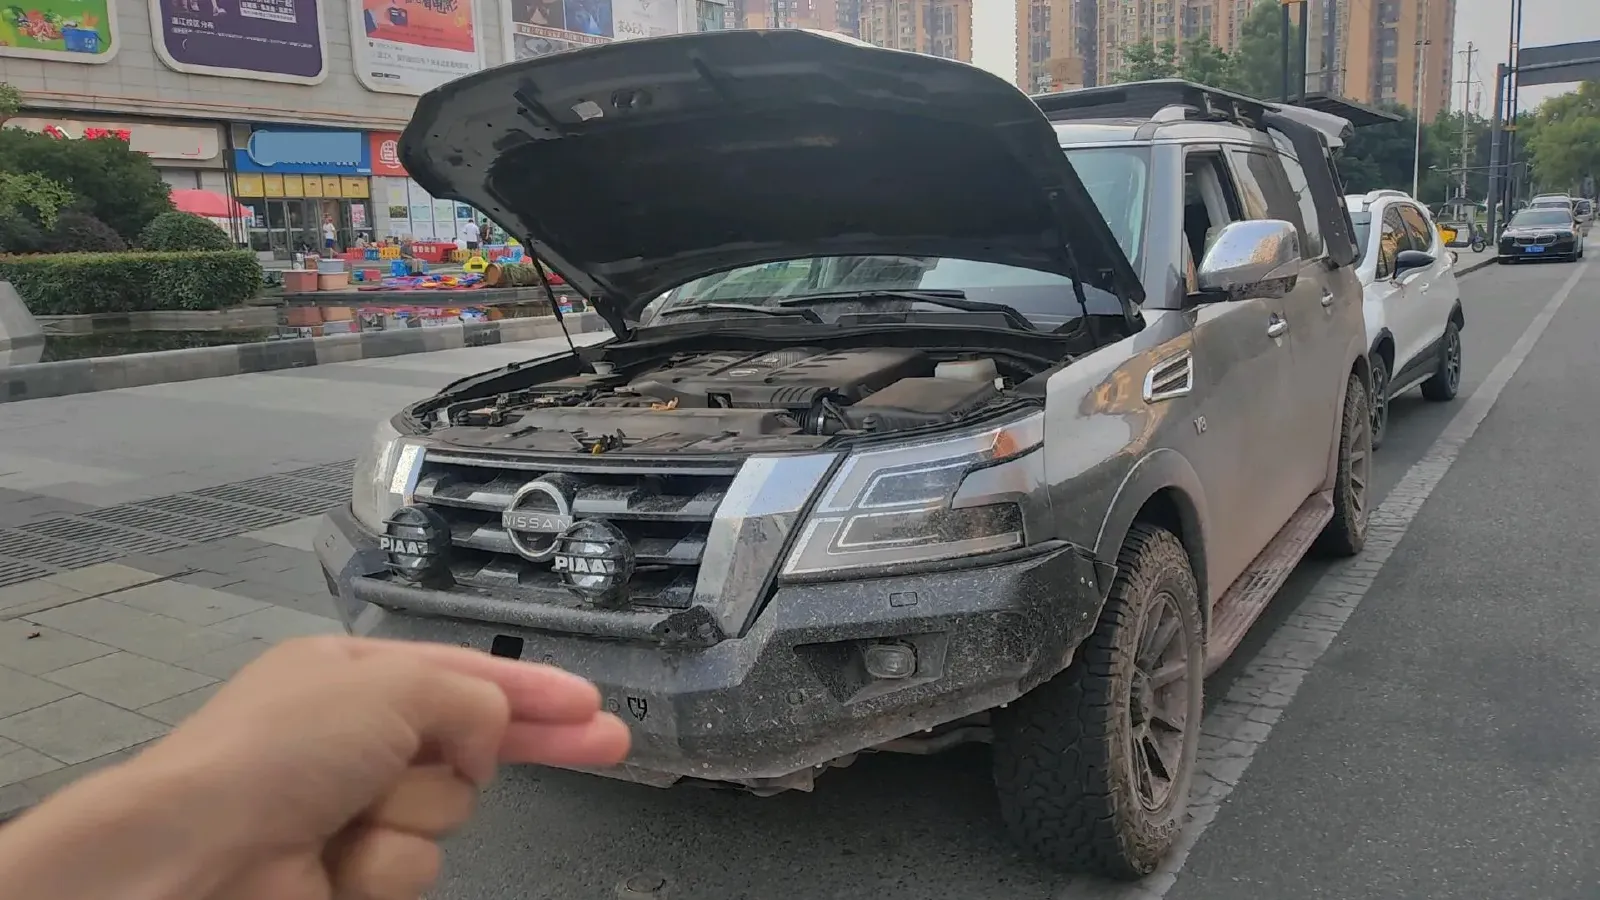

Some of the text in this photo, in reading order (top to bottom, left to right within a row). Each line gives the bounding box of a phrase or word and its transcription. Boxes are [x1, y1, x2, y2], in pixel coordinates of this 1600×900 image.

[1193, 416, 1207, 435] V8
[503, 515, 571, 529] NISSAN
[380, 537, 419, 554] PIAA
[554, 555, 607, 574] PIAA
